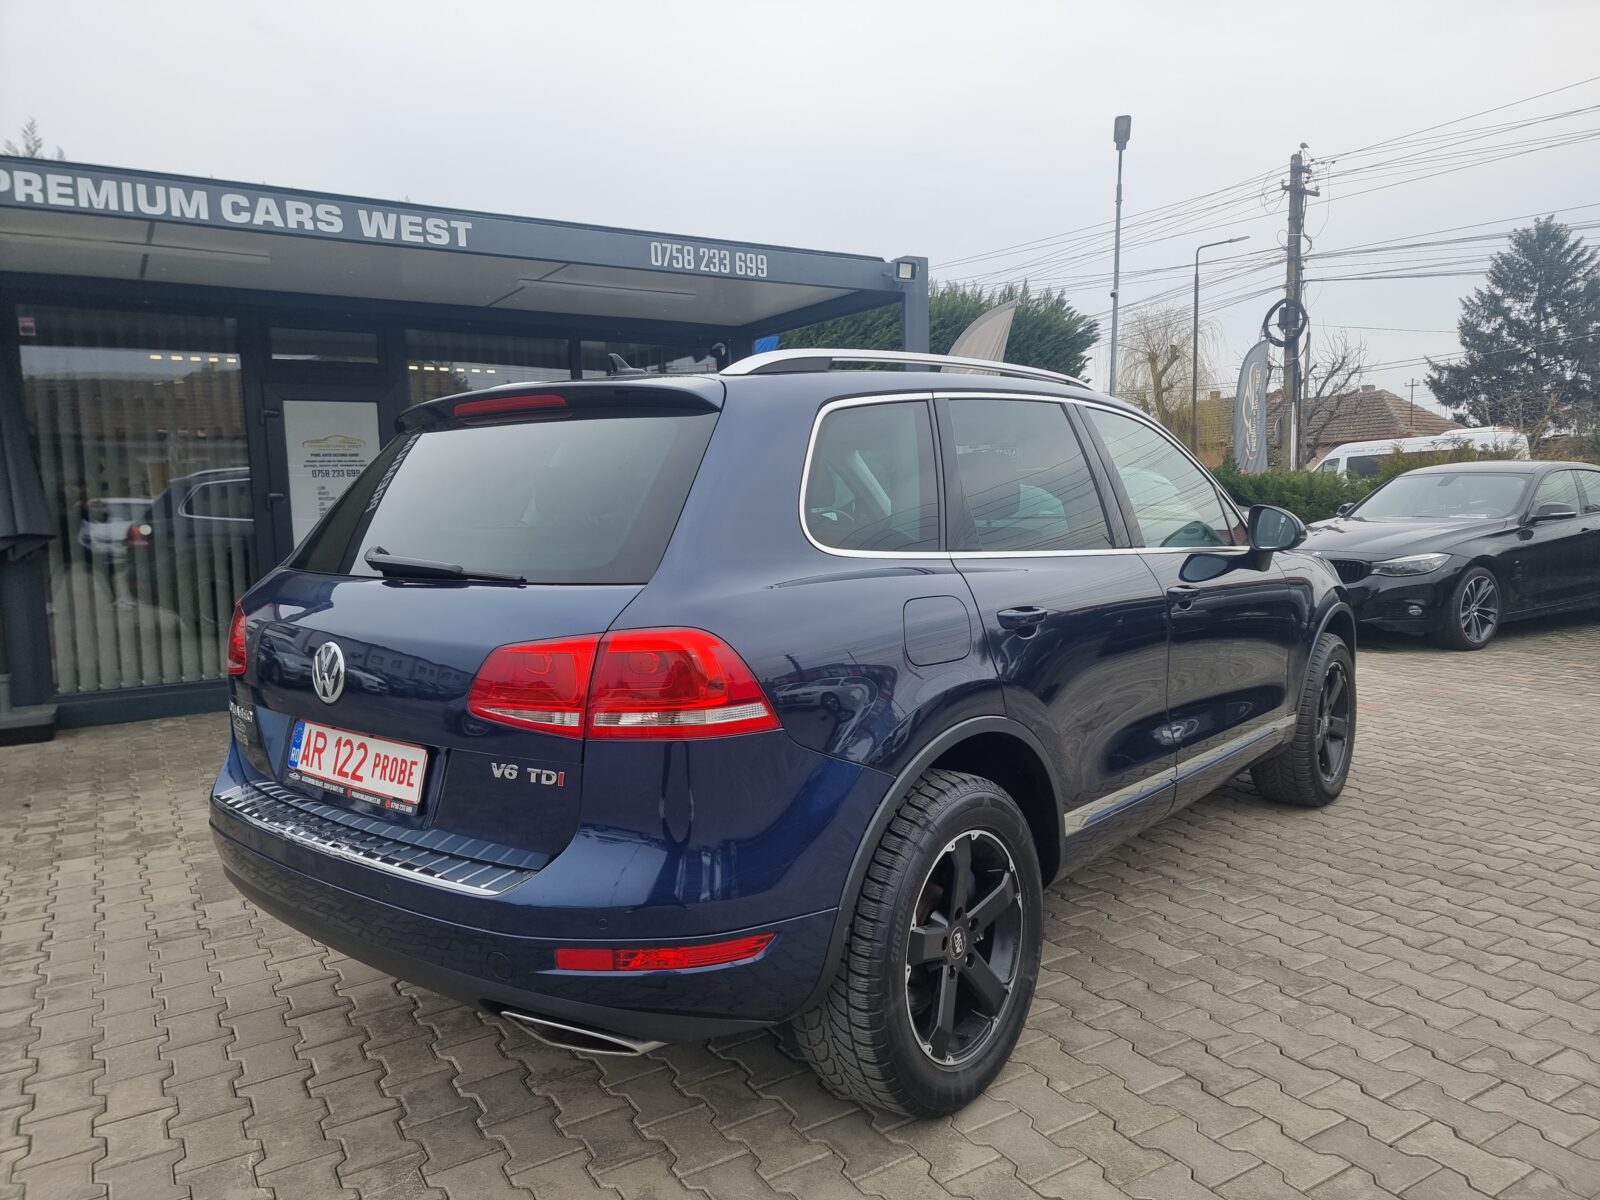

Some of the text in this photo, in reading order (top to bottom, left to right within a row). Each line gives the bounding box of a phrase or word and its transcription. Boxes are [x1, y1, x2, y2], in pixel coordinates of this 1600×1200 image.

[221, 193, 344, 233] CARS
[358, 210, 473, 247] WEST
[650, 242, 768, 278] 0758 233 699
[311, 469, 330, 478] 0758
[331, 469, 345, 478] 233
[299, 729, 327, 770] AR
[332, 736, 368, 782] 122
[371, 752, 418, 787] PROBE
[490, 762, 565, 787] V6 TDI
